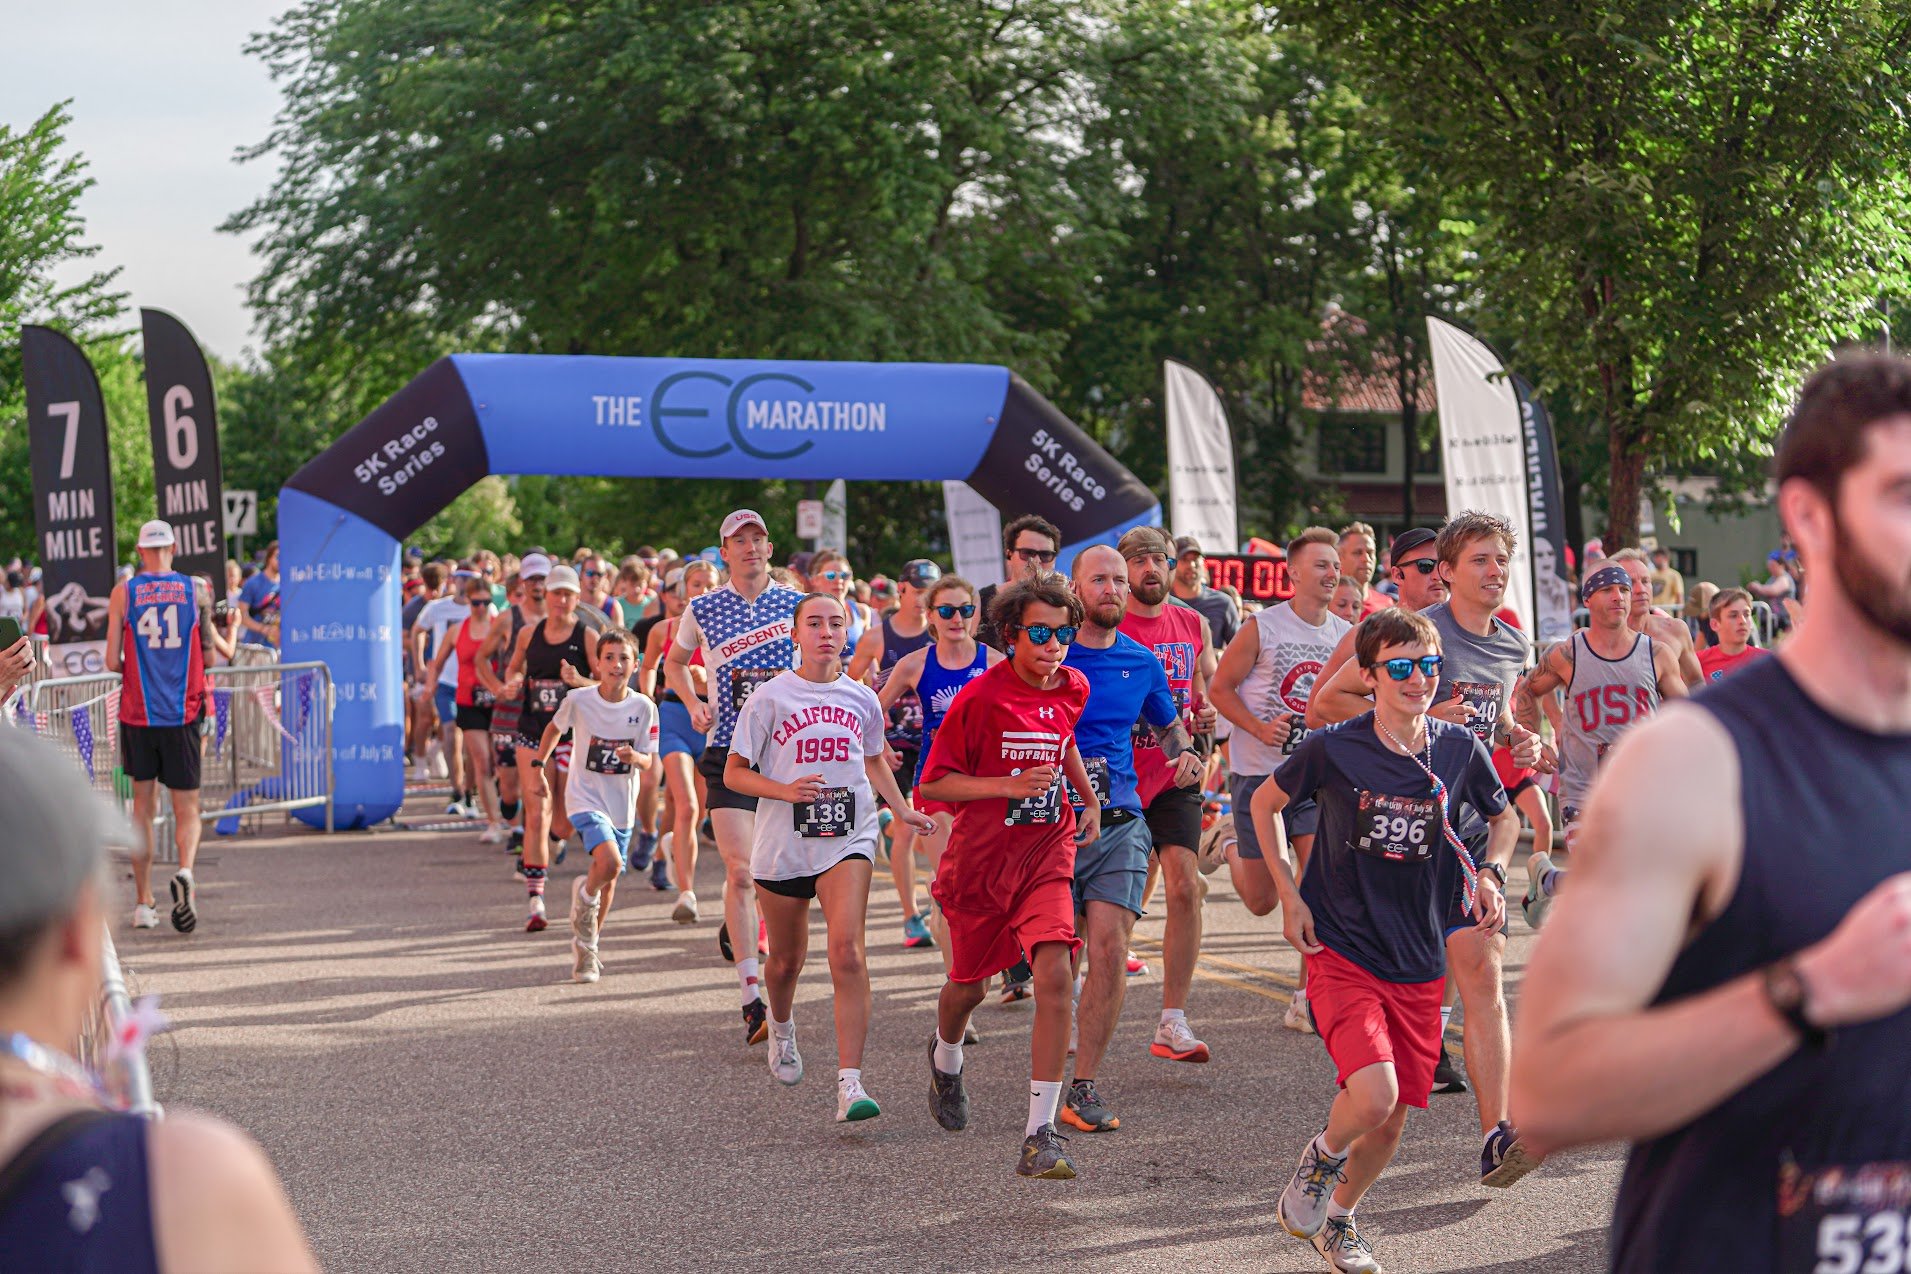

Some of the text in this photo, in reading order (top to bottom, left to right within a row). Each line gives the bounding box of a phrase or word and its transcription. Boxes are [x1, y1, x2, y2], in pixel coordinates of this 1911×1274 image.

[162, 384, 198, 470] 6
[592, 396, 642, 427] THE
[747, 399, 886, 432] MARATHON
[47, 401, 80, 480] 7
[352, 415, 440, 485] 5K Race
[377, 440, 446, 497] Series
[1024, 452, 1086, 513] Series
[1030, 428, 1107, 501] 5K Race
[48, 489, 95, 521] MIN
[165, 479, 209, 516] MIN
[735, 513, 757, 521] USA
[45, 526, 103, 561] MILE
[137, 604, 182, 649] 41
[721, 623, 789, 659] DESCENTE
[539, 689, 558, 702] 61
[1574, 684, 1650, 733] USA
[795, 738, 850, 764] 1995
[1002, 750, 1056, 762] FOOTBALL
[806, 803, 847, 824] 138
[1369, 815, 1427, 844] 396
